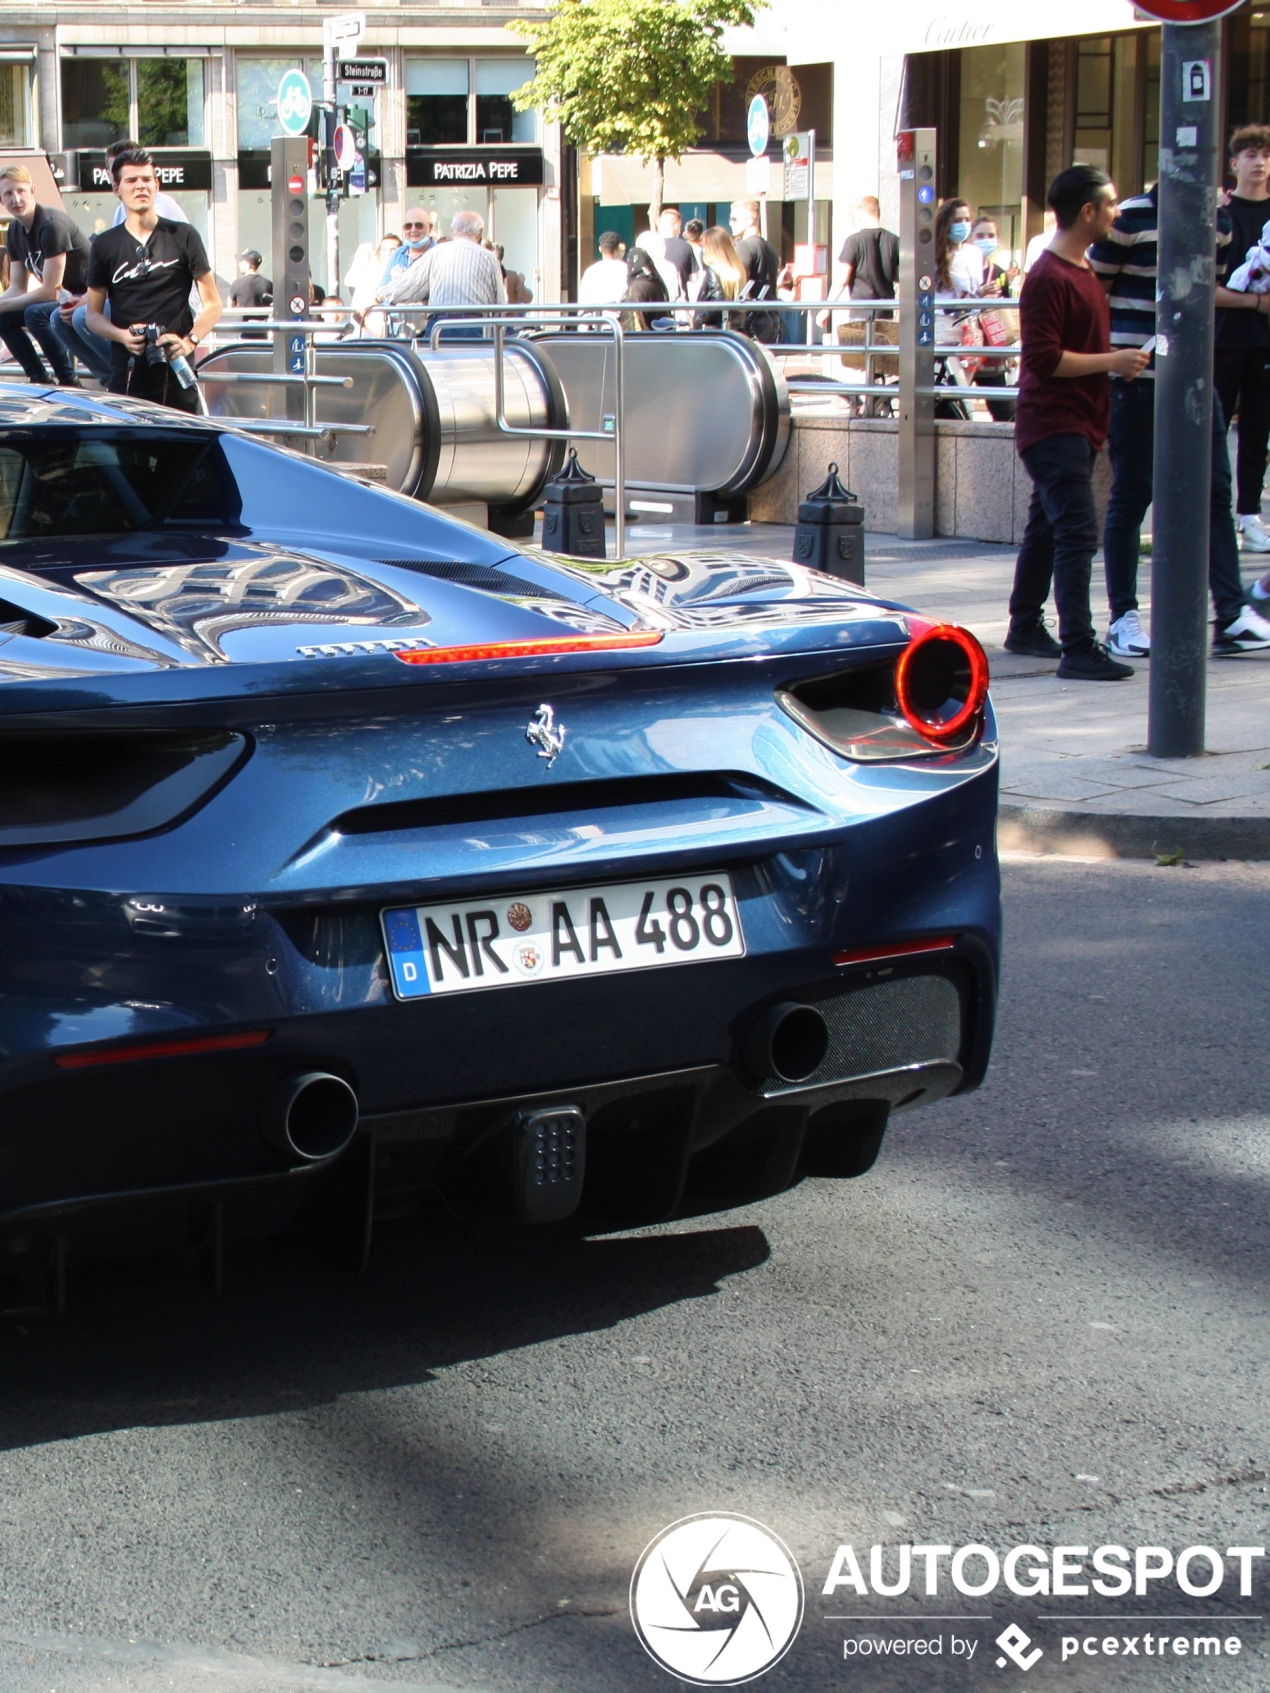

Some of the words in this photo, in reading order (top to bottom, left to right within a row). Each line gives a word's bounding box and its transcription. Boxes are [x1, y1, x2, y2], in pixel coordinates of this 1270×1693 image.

[925, 16, 995, 45] Cartier
[345, 64, 382, 79] Steinstraße
[155, 167, 184, 184] PEPE
[434, 163, 486, 180] PATRIZIA
[489, 162, 518, 179] PEPE
[425, 909, 509, 982] NR
[551, 896, 623, 967] AA
[634, 883, 733, 953] 488
[402, 962, 418, 982] D
